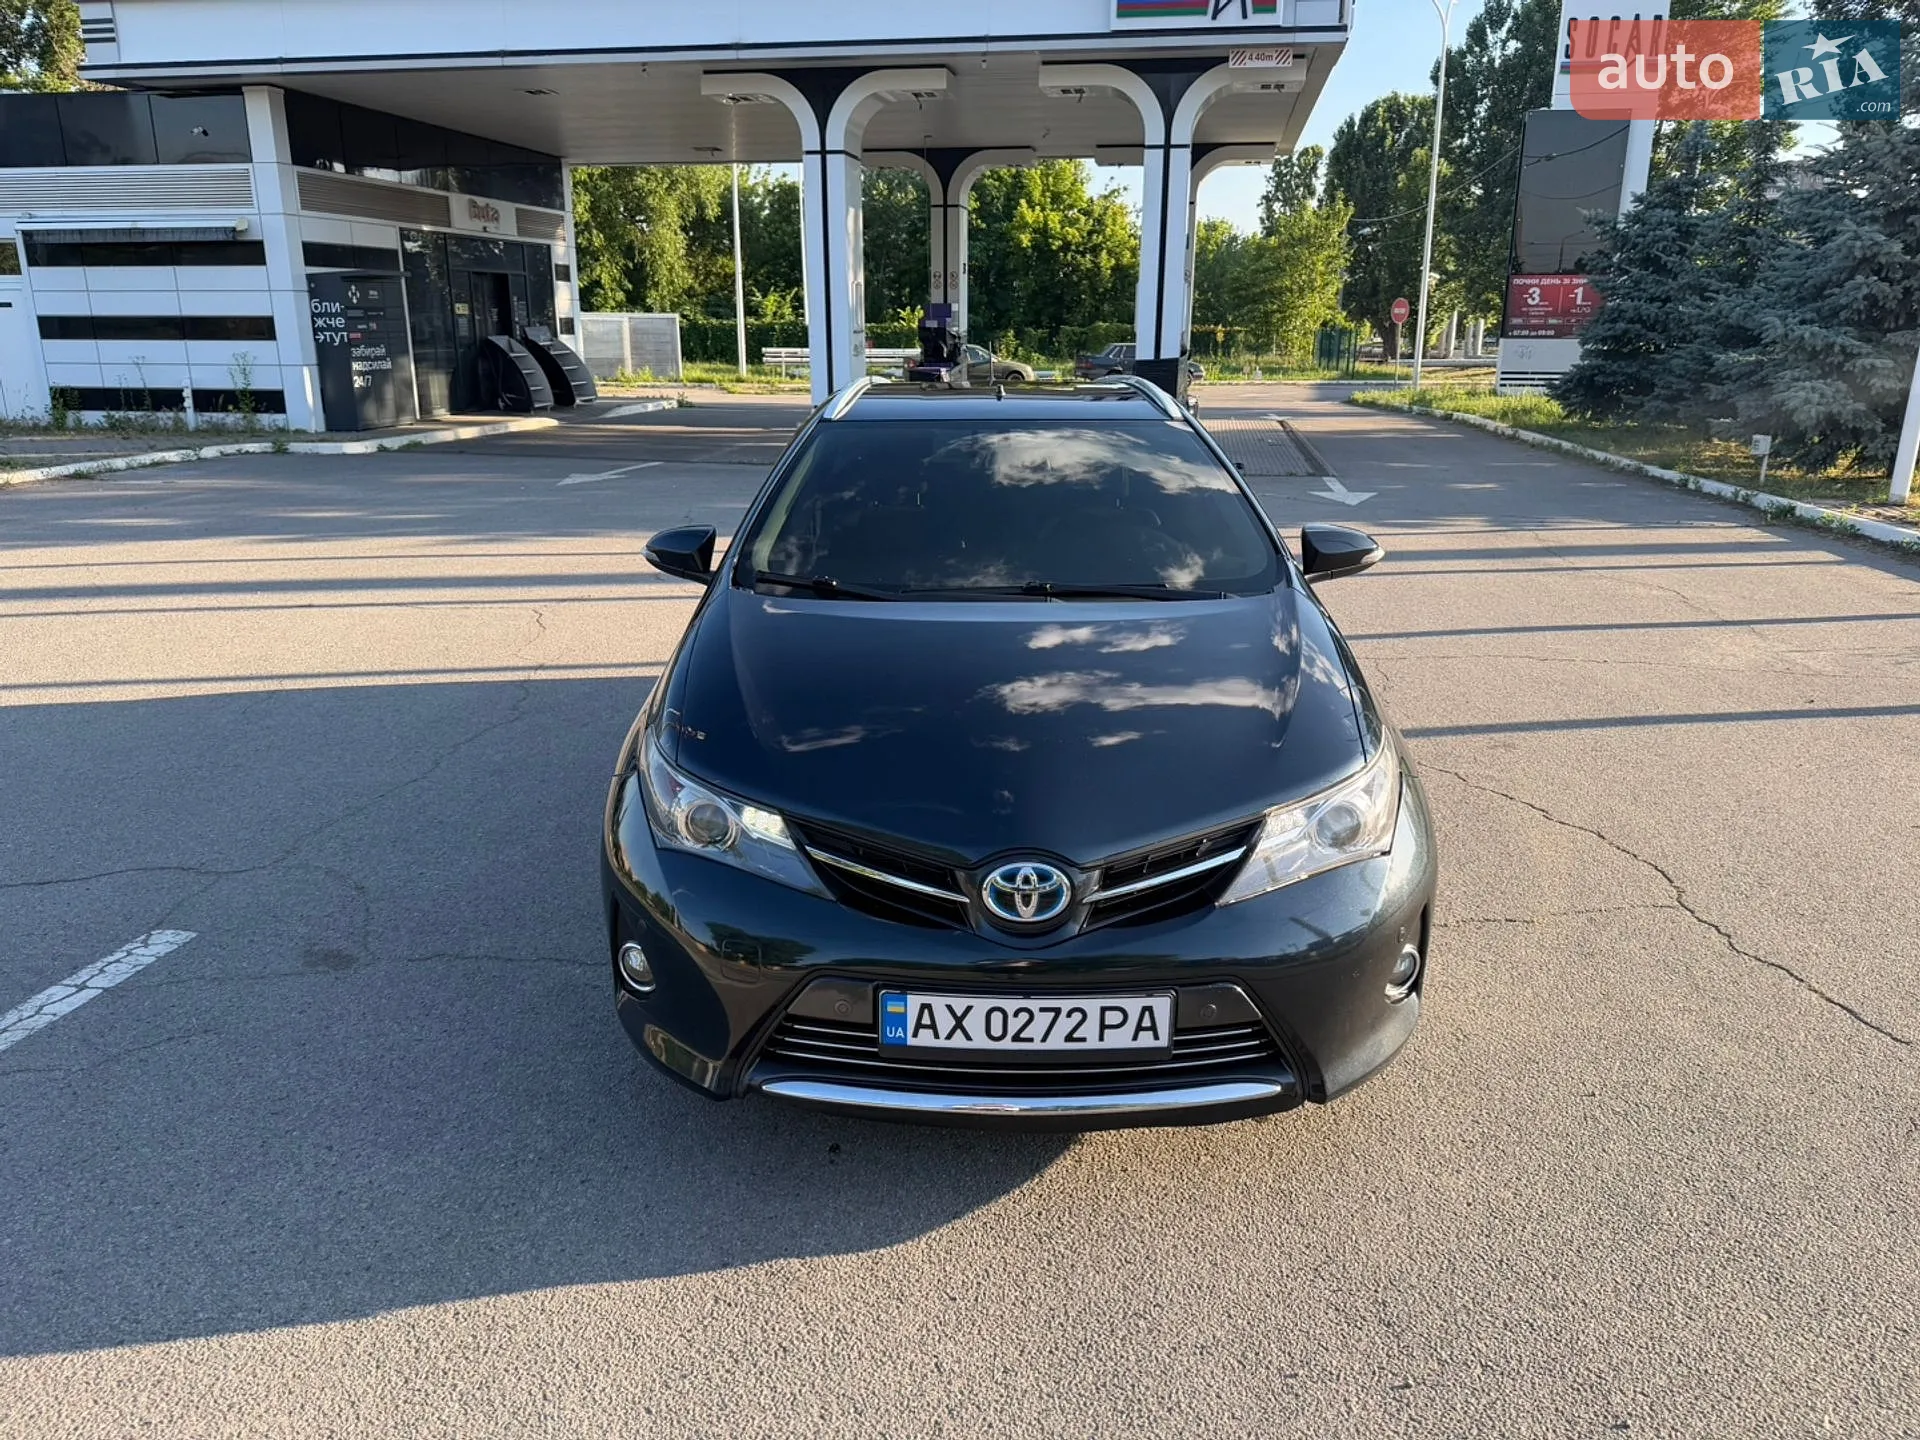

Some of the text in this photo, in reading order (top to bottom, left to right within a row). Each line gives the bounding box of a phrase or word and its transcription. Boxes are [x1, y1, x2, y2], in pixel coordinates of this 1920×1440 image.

[1564, 13, 1664, 59] SOCAR
[1522, 287, 1541, 305] -3
[310, 299, 345, 313] бли-
[313, 316, 345, 328] жче
[350, 344, 386, 358] забирай
[352, 358, 392, 372] надсилай
[353, 375, 372, 388] 24/7
[886, 1002, 1160, 1043] UA AX 0272 PA
